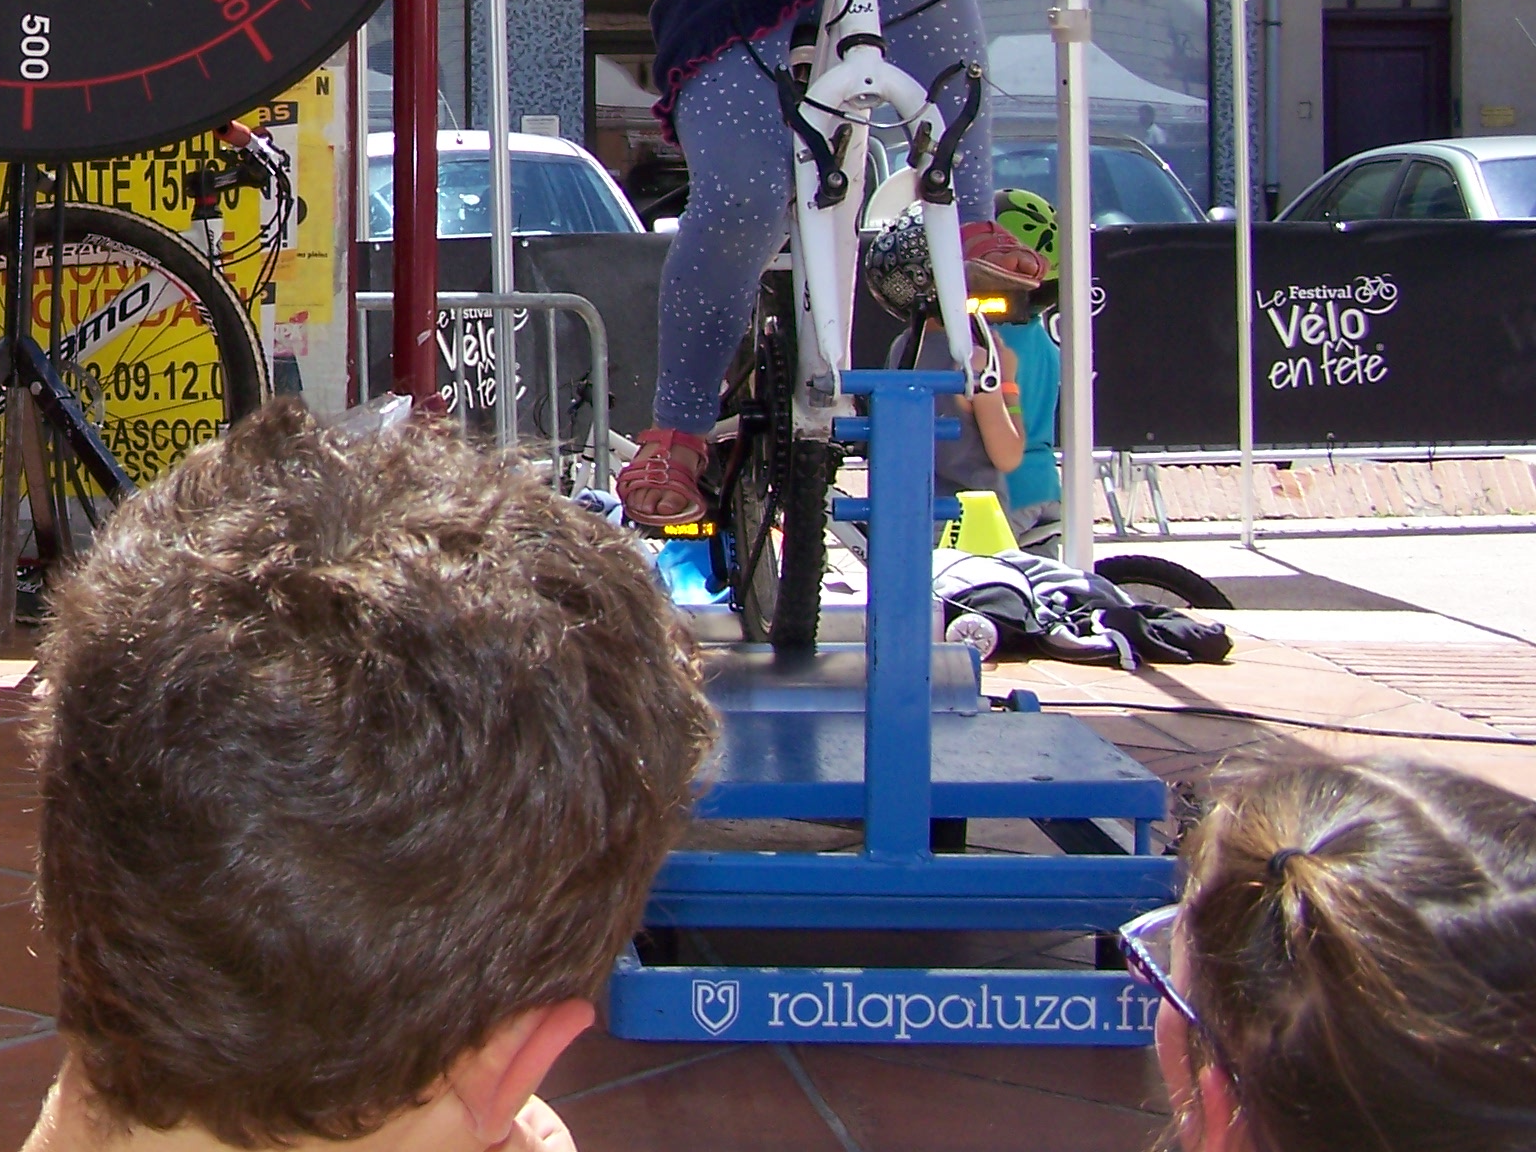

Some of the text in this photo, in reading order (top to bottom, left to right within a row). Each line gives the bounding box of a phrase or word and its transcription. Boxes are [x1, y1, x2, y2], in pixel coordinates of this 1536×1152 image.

[19, 12, 51, 81] 500
[1256, 284, 1353, 310] Le Festival
[1267, 299, 1369, 349] Vélo
[1268, 338, 1389, 390] en fête
[767, 980, 1157, 1040] rollapaluza.fr
